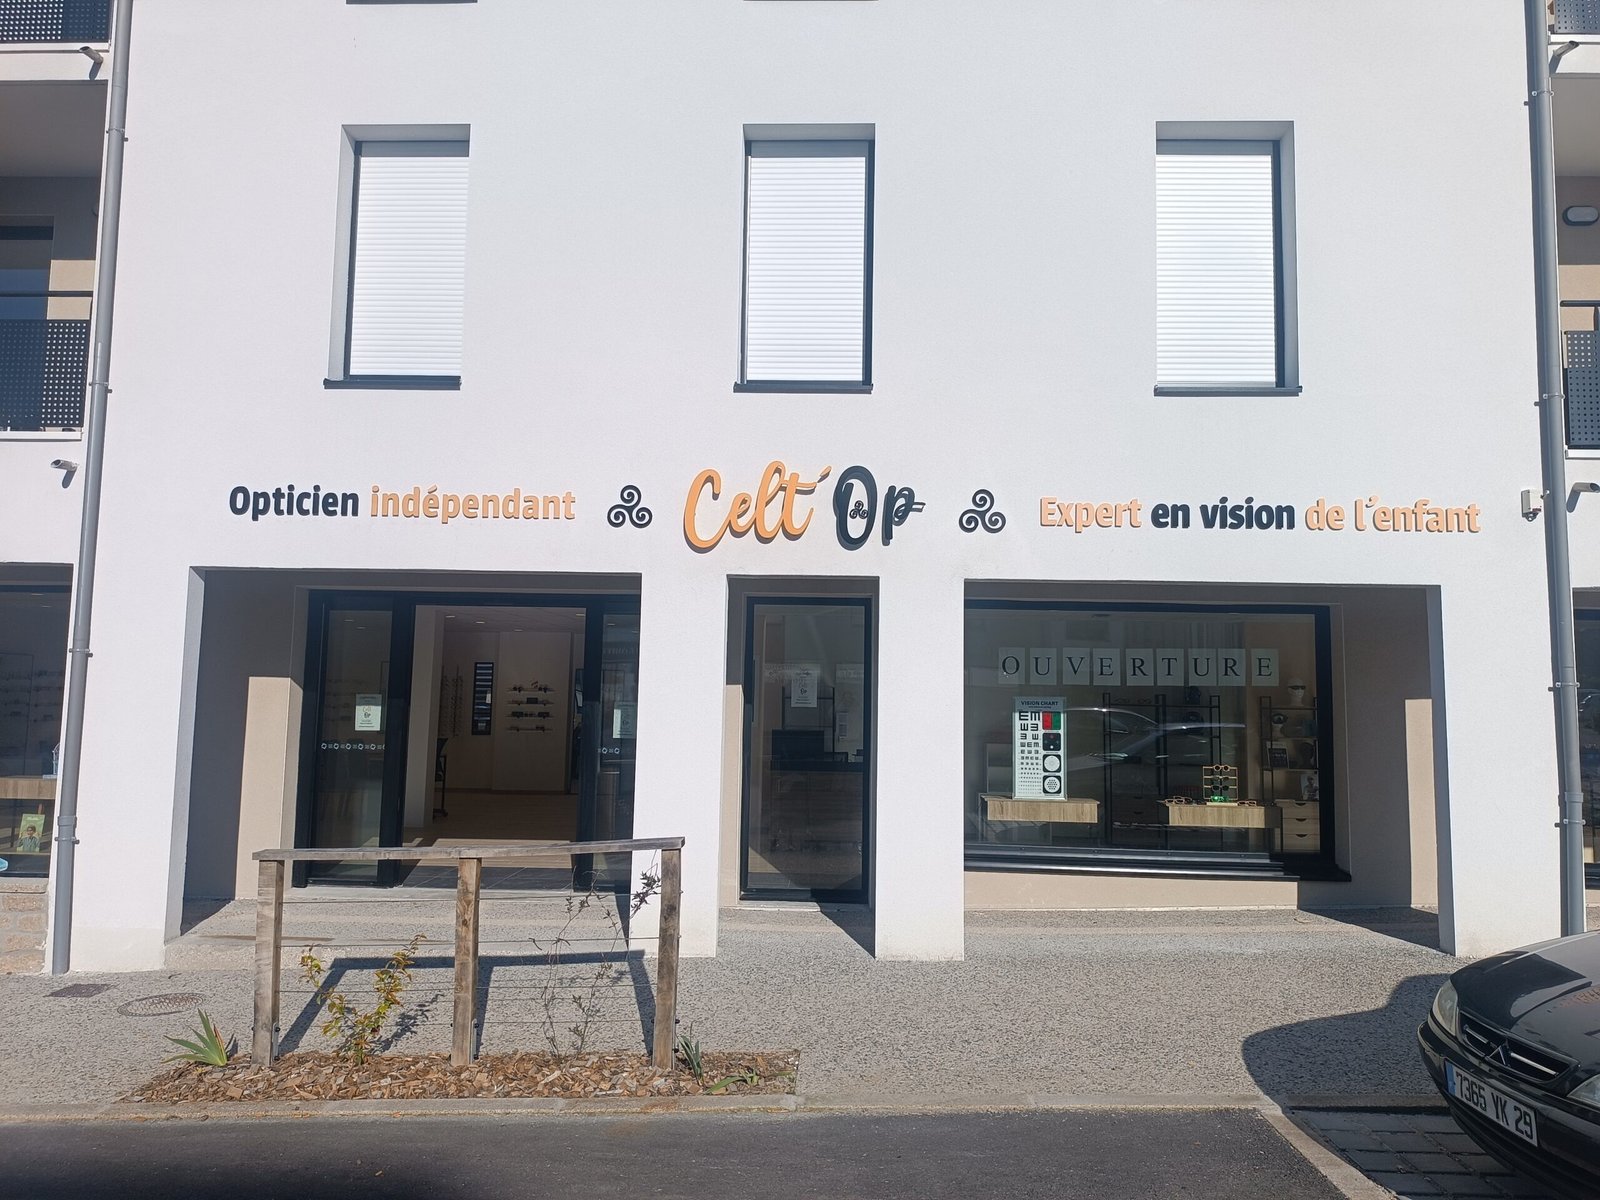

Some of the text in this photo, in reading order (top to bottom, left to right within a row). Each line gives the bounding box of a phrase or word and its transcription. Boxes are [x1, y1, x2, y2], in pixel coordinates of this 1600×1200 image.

[229, 484, 576, 524] Opticien indépendant
[1040, 495, 1481, 533] Expert en vision de l'enfant
[1001, 655, 1273, 676] OUVERTURE
[1456, 1071, 1533, 1140] 7365 YK 29
